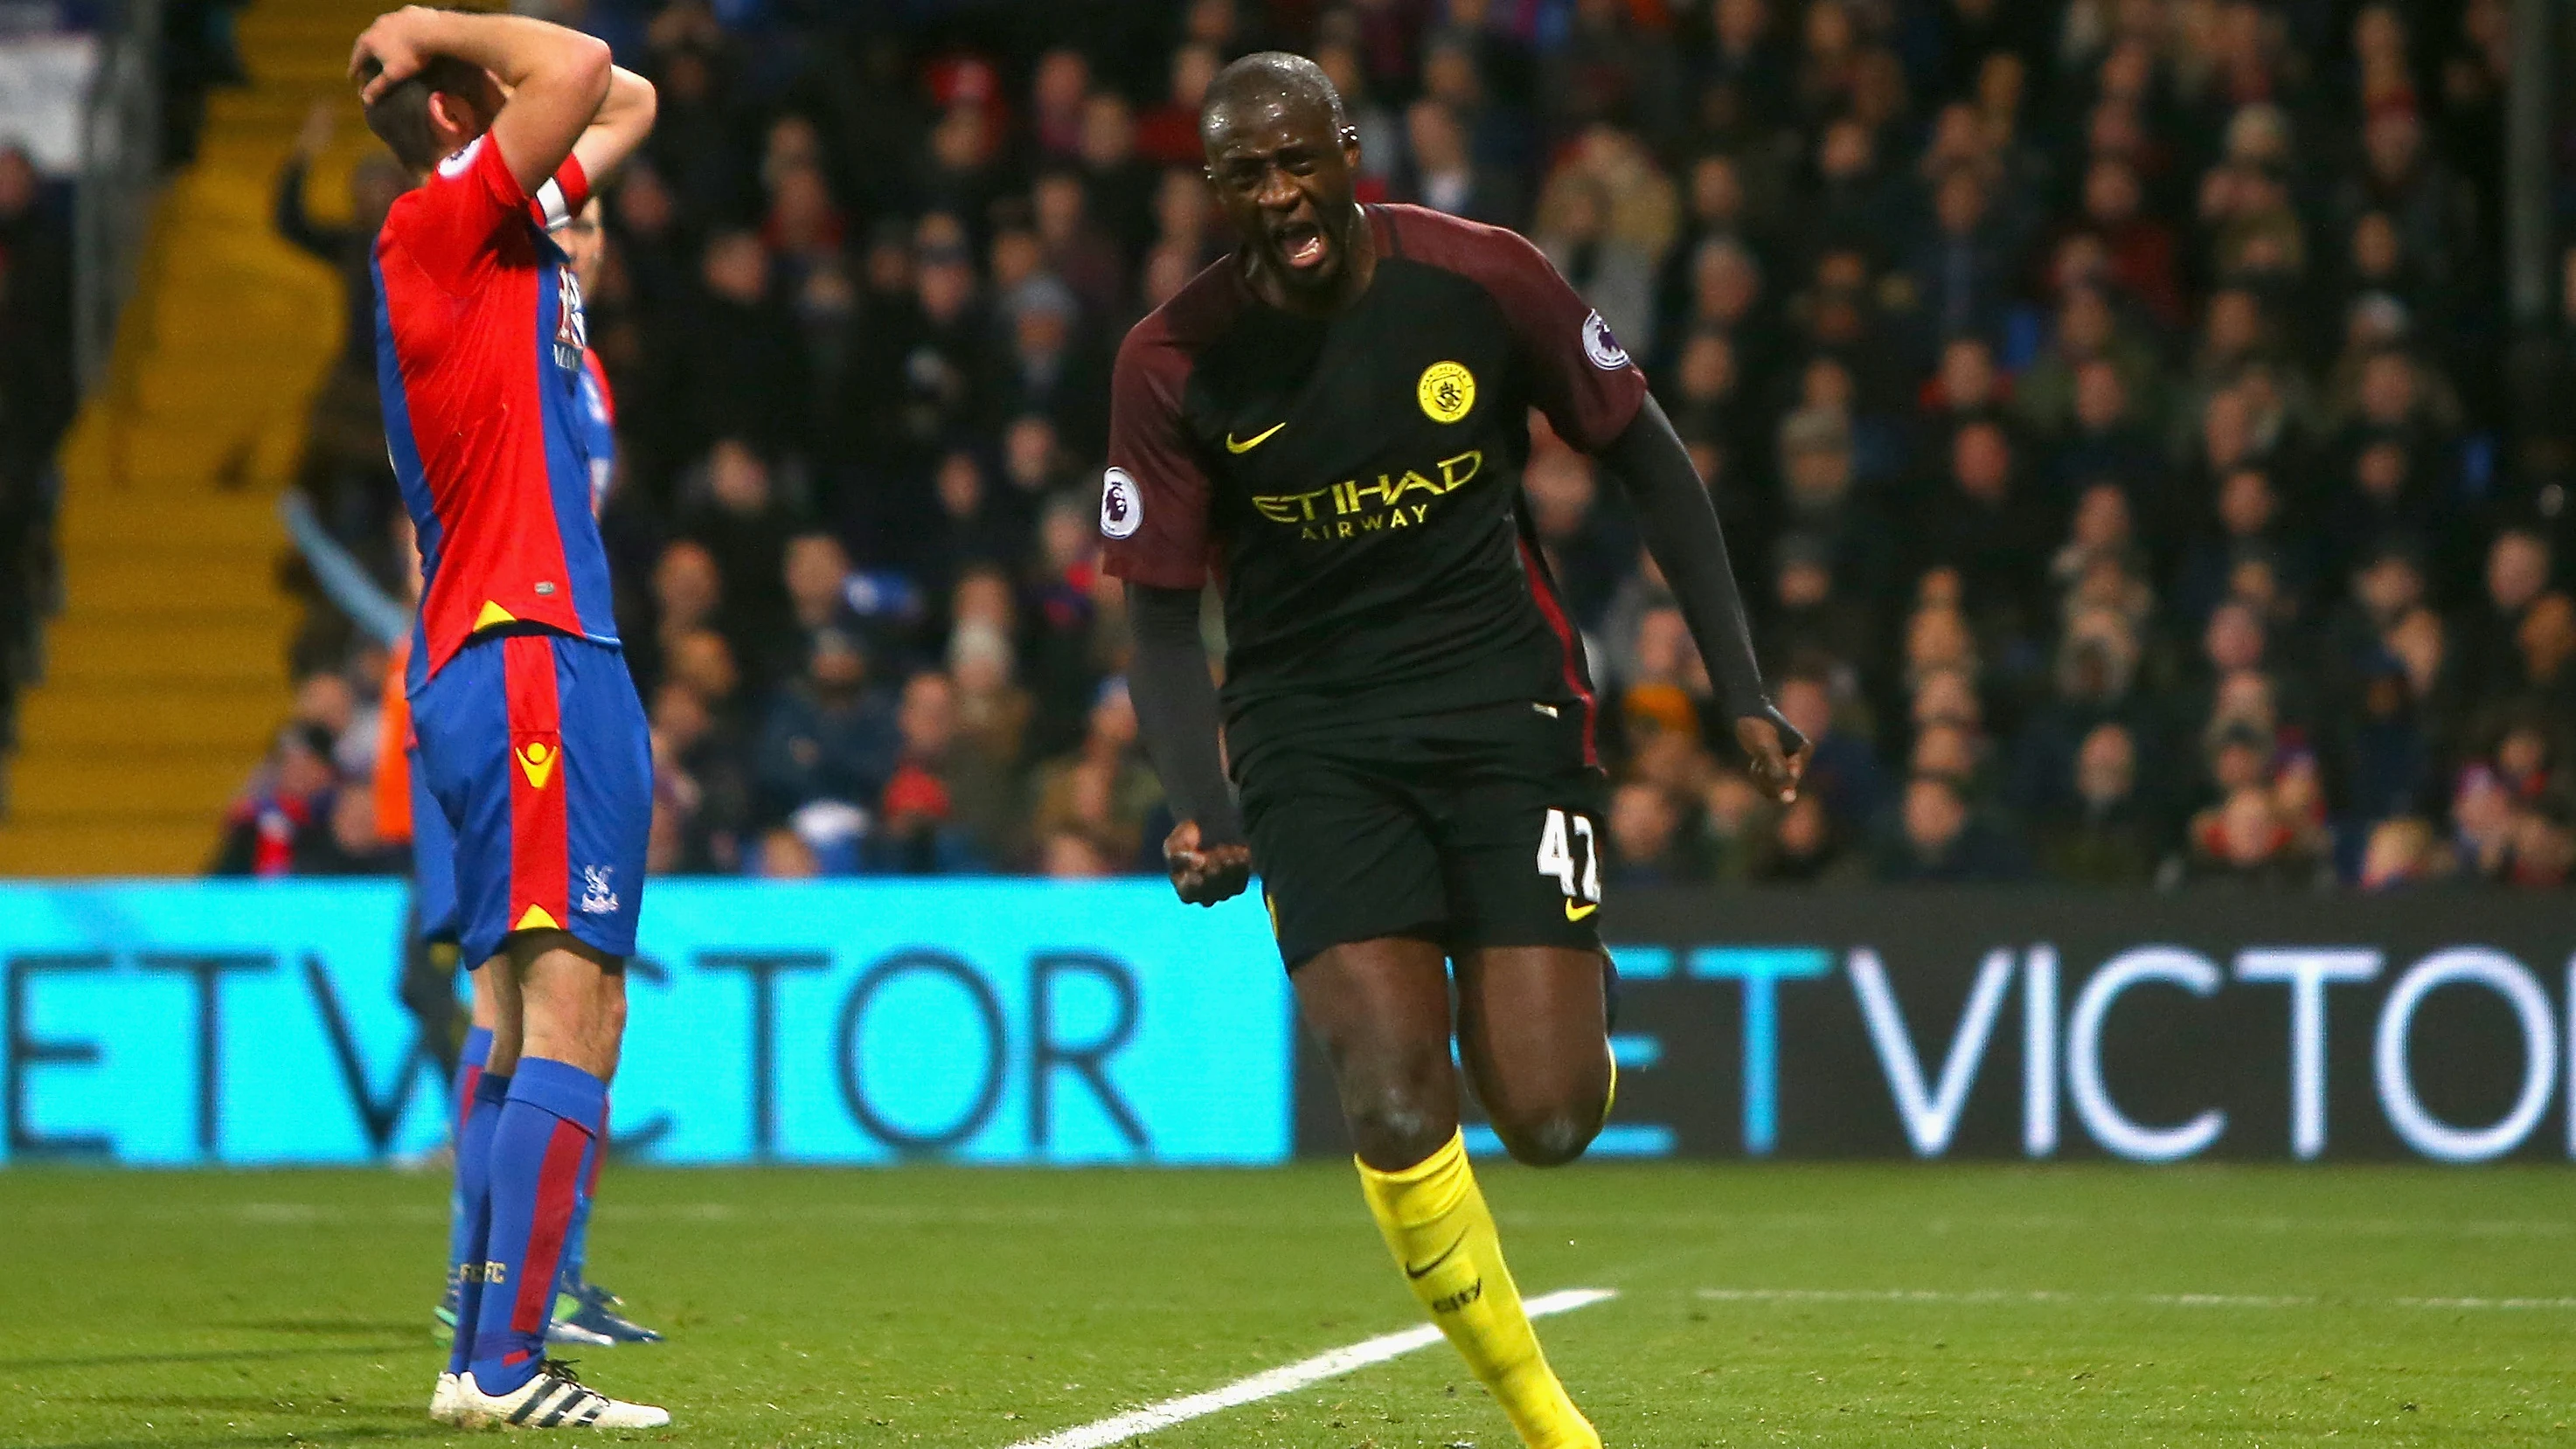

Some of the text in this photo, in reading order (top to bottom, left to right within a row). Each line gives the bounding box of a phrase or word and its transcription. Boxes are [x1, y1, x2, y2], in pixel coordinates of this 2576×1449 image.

[1253, 450, 1482, 523] ETIHAD
[1302, 504, 1427, 540] AIRWAY
[9, 948, 1156, 1157] ETVTOR
[1447, 946, 2576, 1161] ETVICTO
